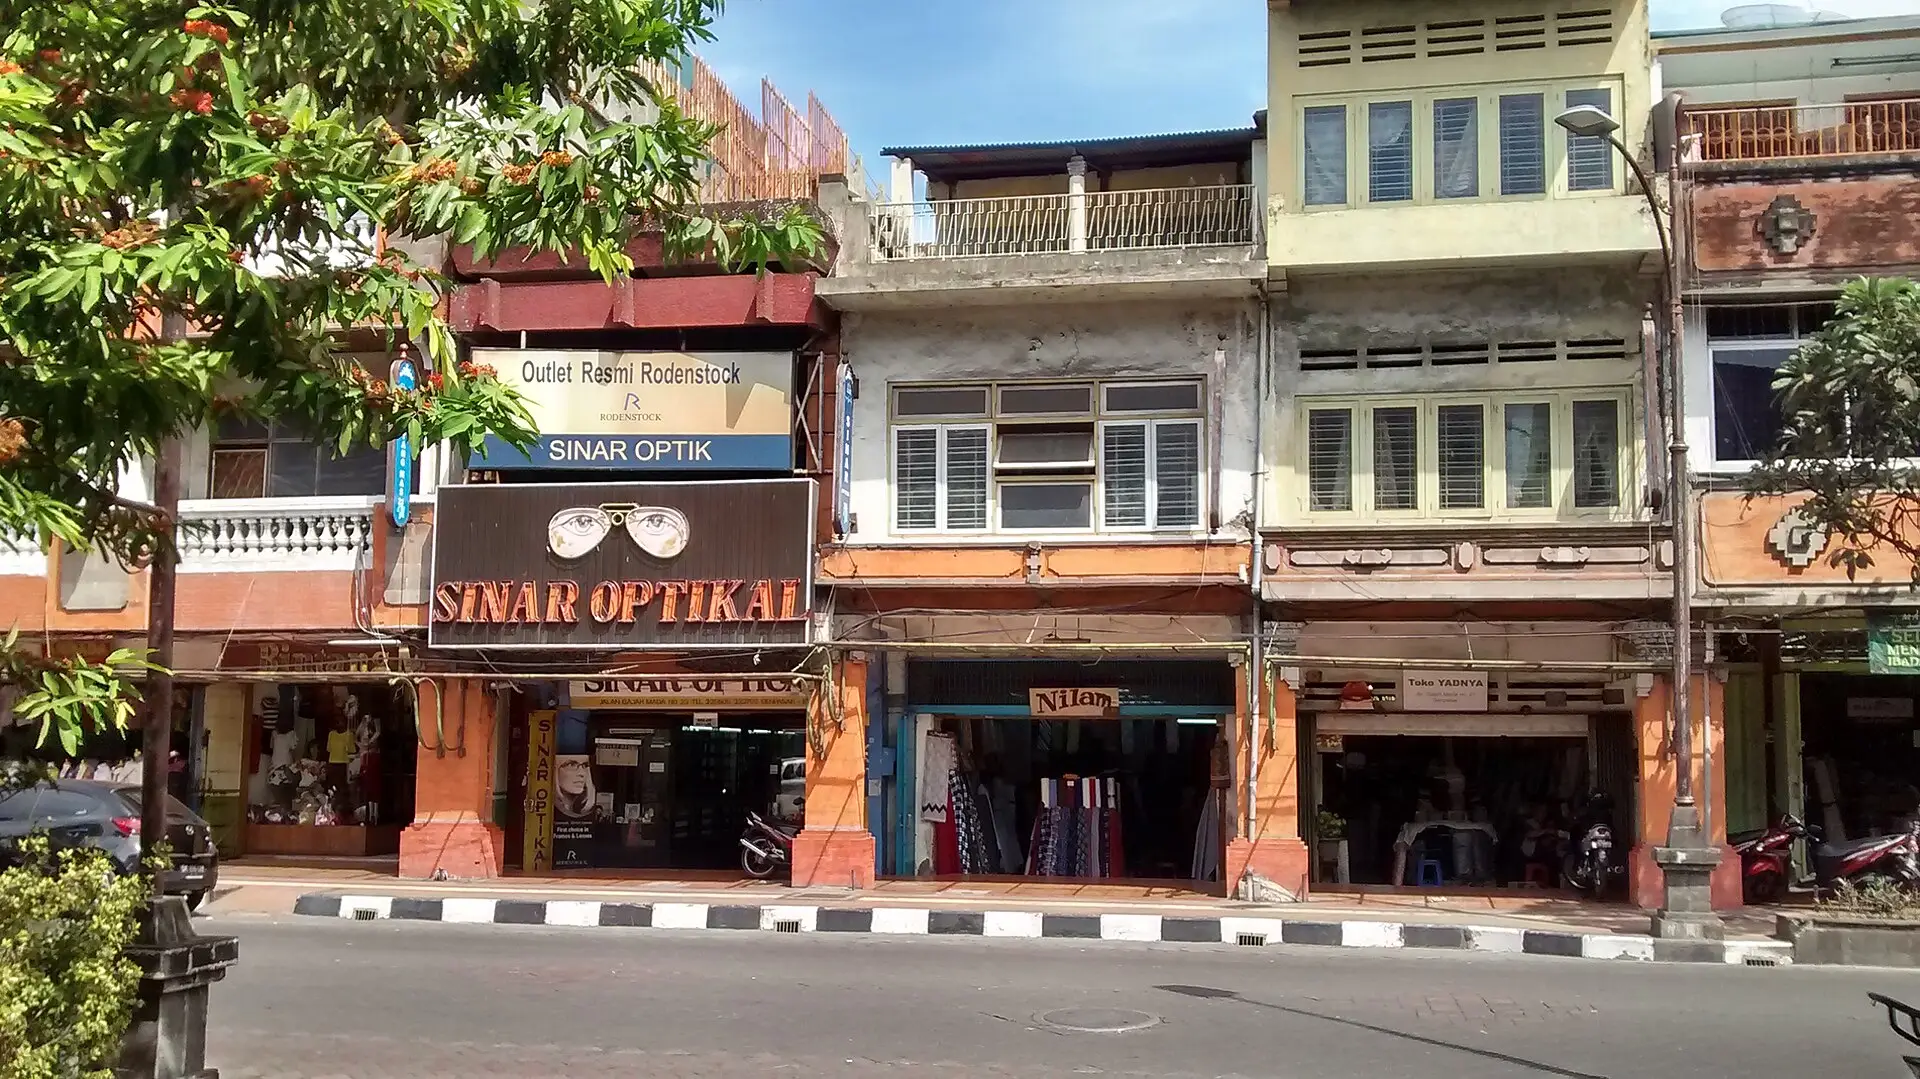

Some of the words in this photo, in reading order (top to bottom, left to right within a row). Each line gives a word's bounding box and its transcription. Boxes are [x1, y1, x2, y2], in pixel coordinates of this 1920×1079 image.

[522, 360, 572, 384] Outlet
[581, 360, 634, 385] Resmi
[640, 360, 741, 385] Rodenstock
[599, 412, 662, 422] RODENSTOCK
[548, 440, 627, 461] SINAR
[634, 440, 712, 461] OPTIK
[432, 580, 580, 623] SINAR
[1408, 678, 1434, 687] Toko
[1438, 678, 1484, 687] YADNYA
[1035, 688, 1112, 714] Nilam
[536, 719, 551, 781] SINAR
